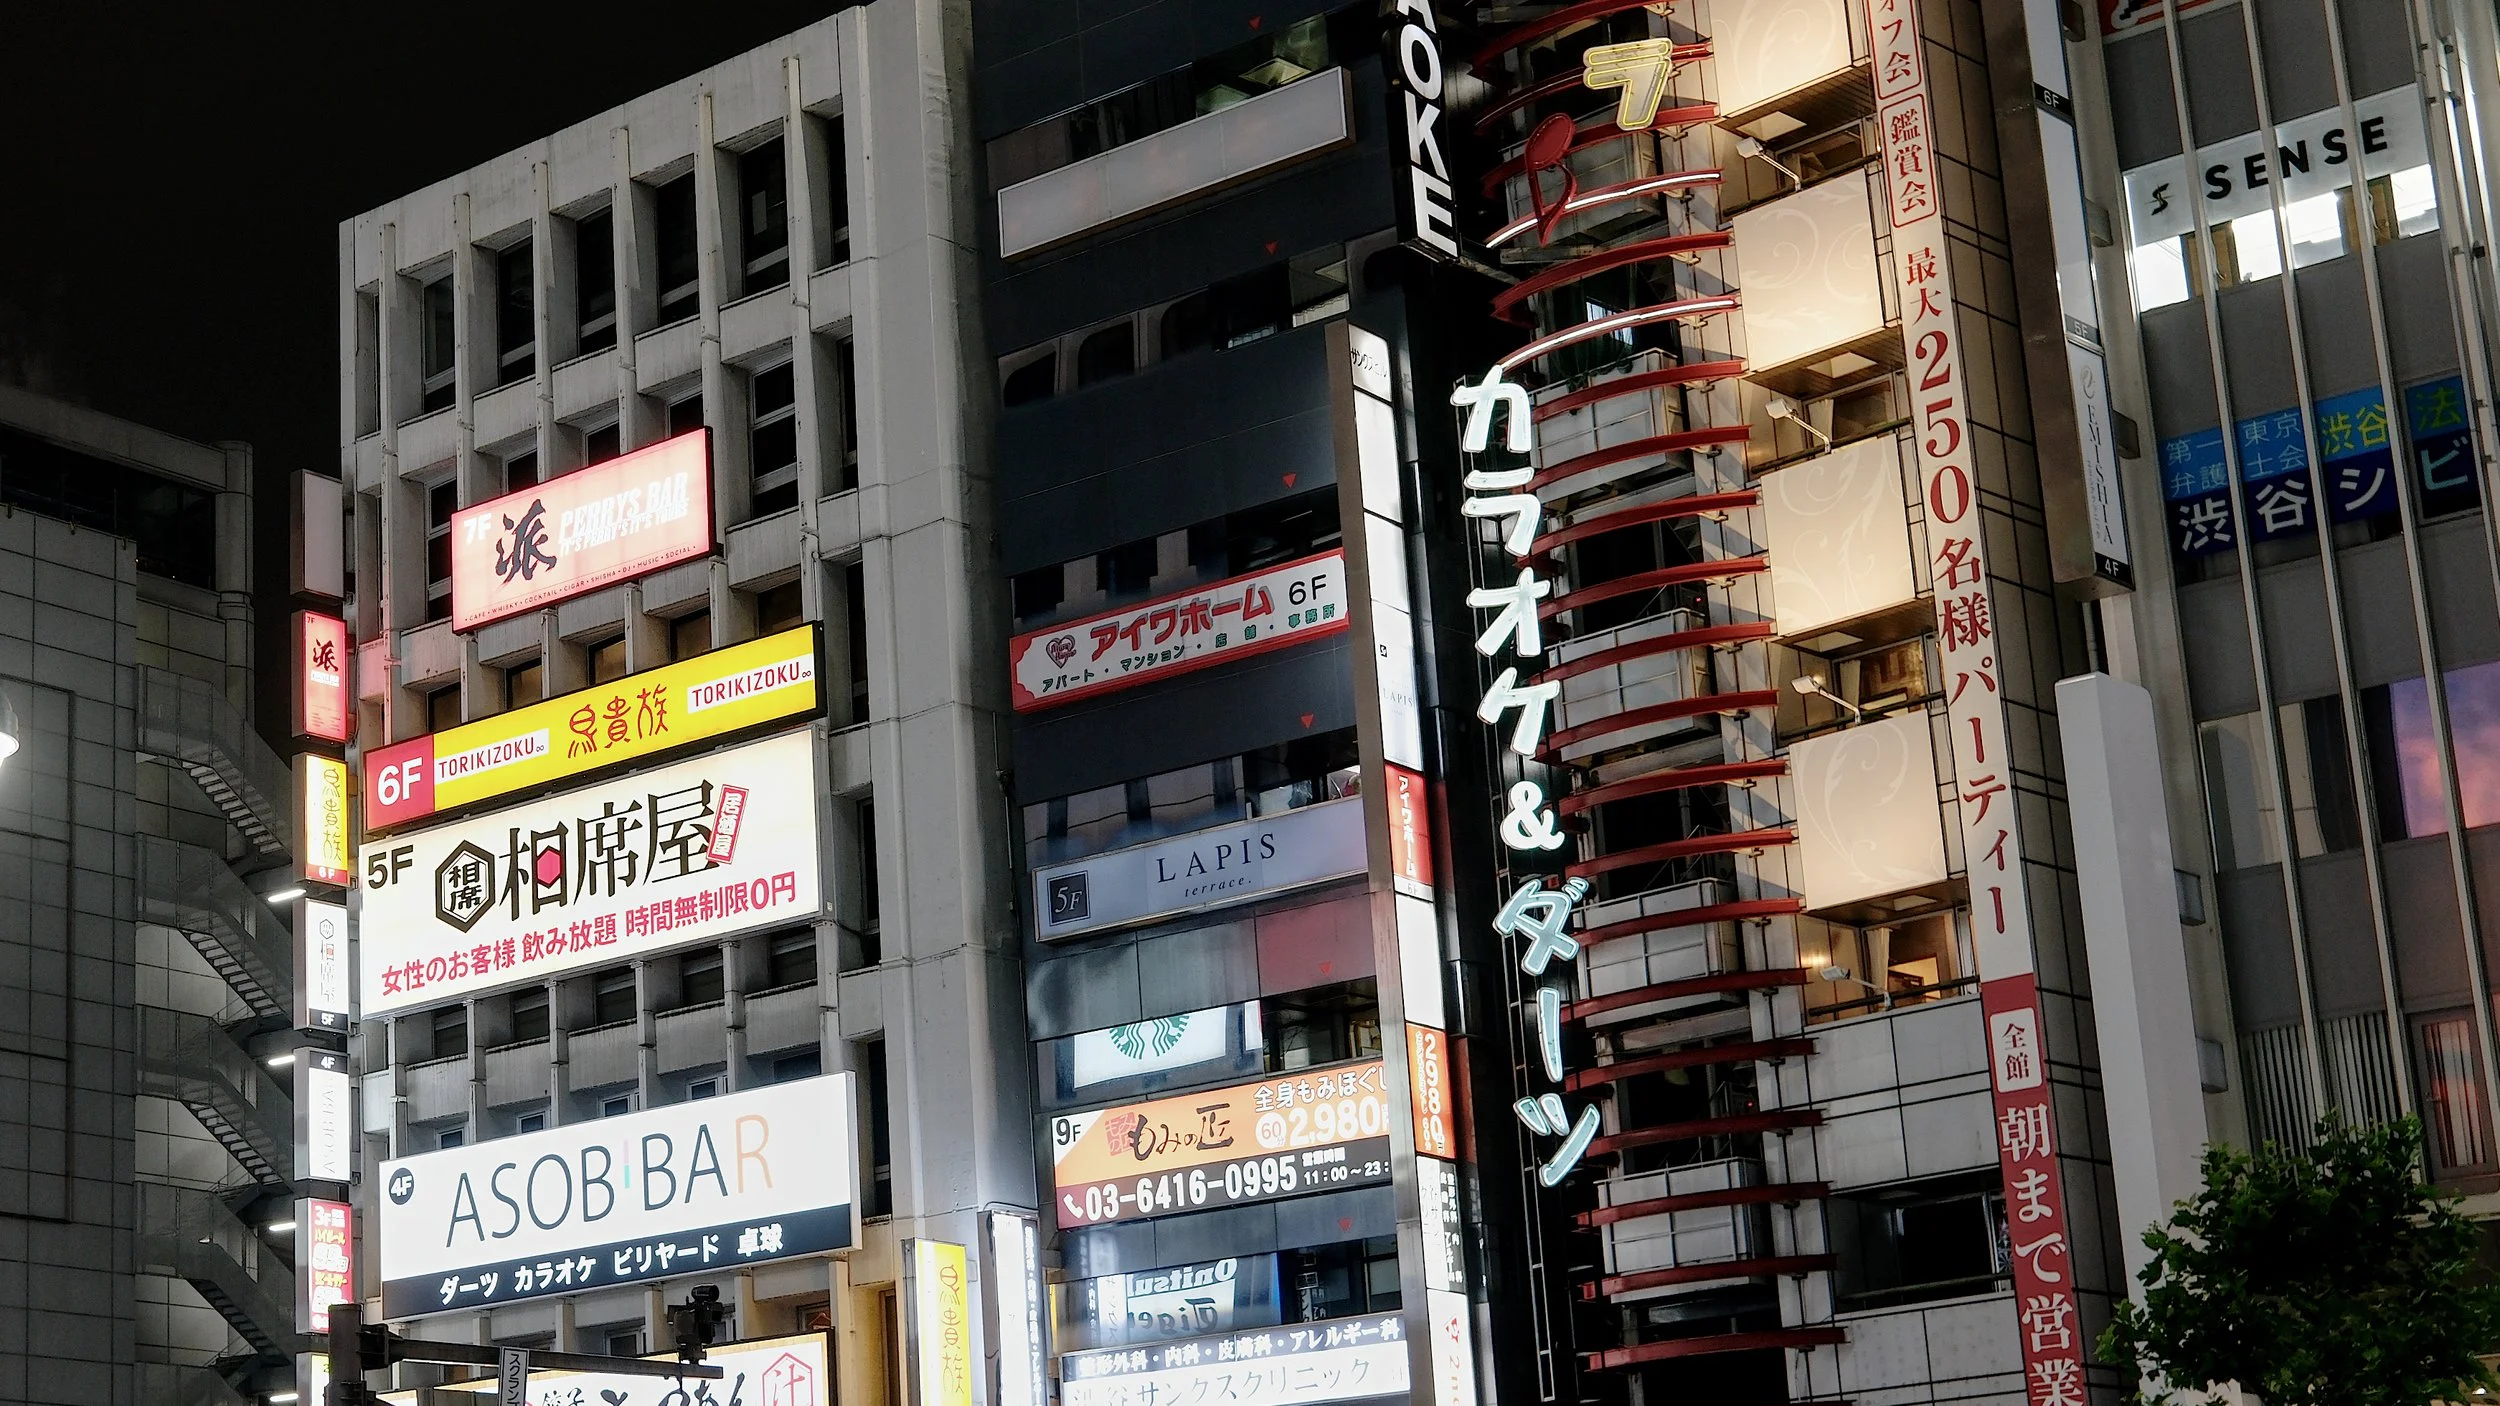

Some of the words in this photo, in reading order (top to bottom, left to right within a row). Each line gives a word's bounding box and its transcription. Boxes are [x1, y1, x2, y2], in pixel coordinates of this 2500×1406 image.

[2043, 89, 2060, 108] 6F
[1890, 108, 1927, 214] 鑑賞会
[2205, 116, 2388, 200] SENSE
[464, 512, 492, 546] 7F
[495, 498, 557, 588] 派
[1288, 574, 1328, 606] 6F
[2104, 558, 2120, 577] 4F
[1089, 583, 1274, 662] アイワホーム
[1042, 667, 1096, 693] アパート
[1120, 645, 1185, 672] マンション
[377, 757, 424, 806] 6F
[318, 866, 336, 879] 6F
[368, 844, 414, 890] 5F
[498, 779, 719, 922] 相席屋
[1156, 832, 1276, 884] LAPIS
[1055, 886, 1083, 914] 5F
[381, 935, 515, 997] 女性のお客様
[522, 912, 618, 963] 飲み放題
[321, 1012, 335, 1026] 5F
[321, 1056, 335, 1068] 4F
[2001, 1023, 2030, 1081] 全館
[1056, 1118, 1082, 1146] 9F
[1128, 1102, 1234, 1162] もみの匠
[390, 1175, 413, 1197] 4F
[1085, 1156, 1297, 1222] 03-6416-0995
[439, 1271, 500, 1306] ダーツ
[514, 1255, 597, 1293] カラオケ
[614, 1234, 719, 1276] ビリヤード
[737, 1222, 784, 1257] 卓球
